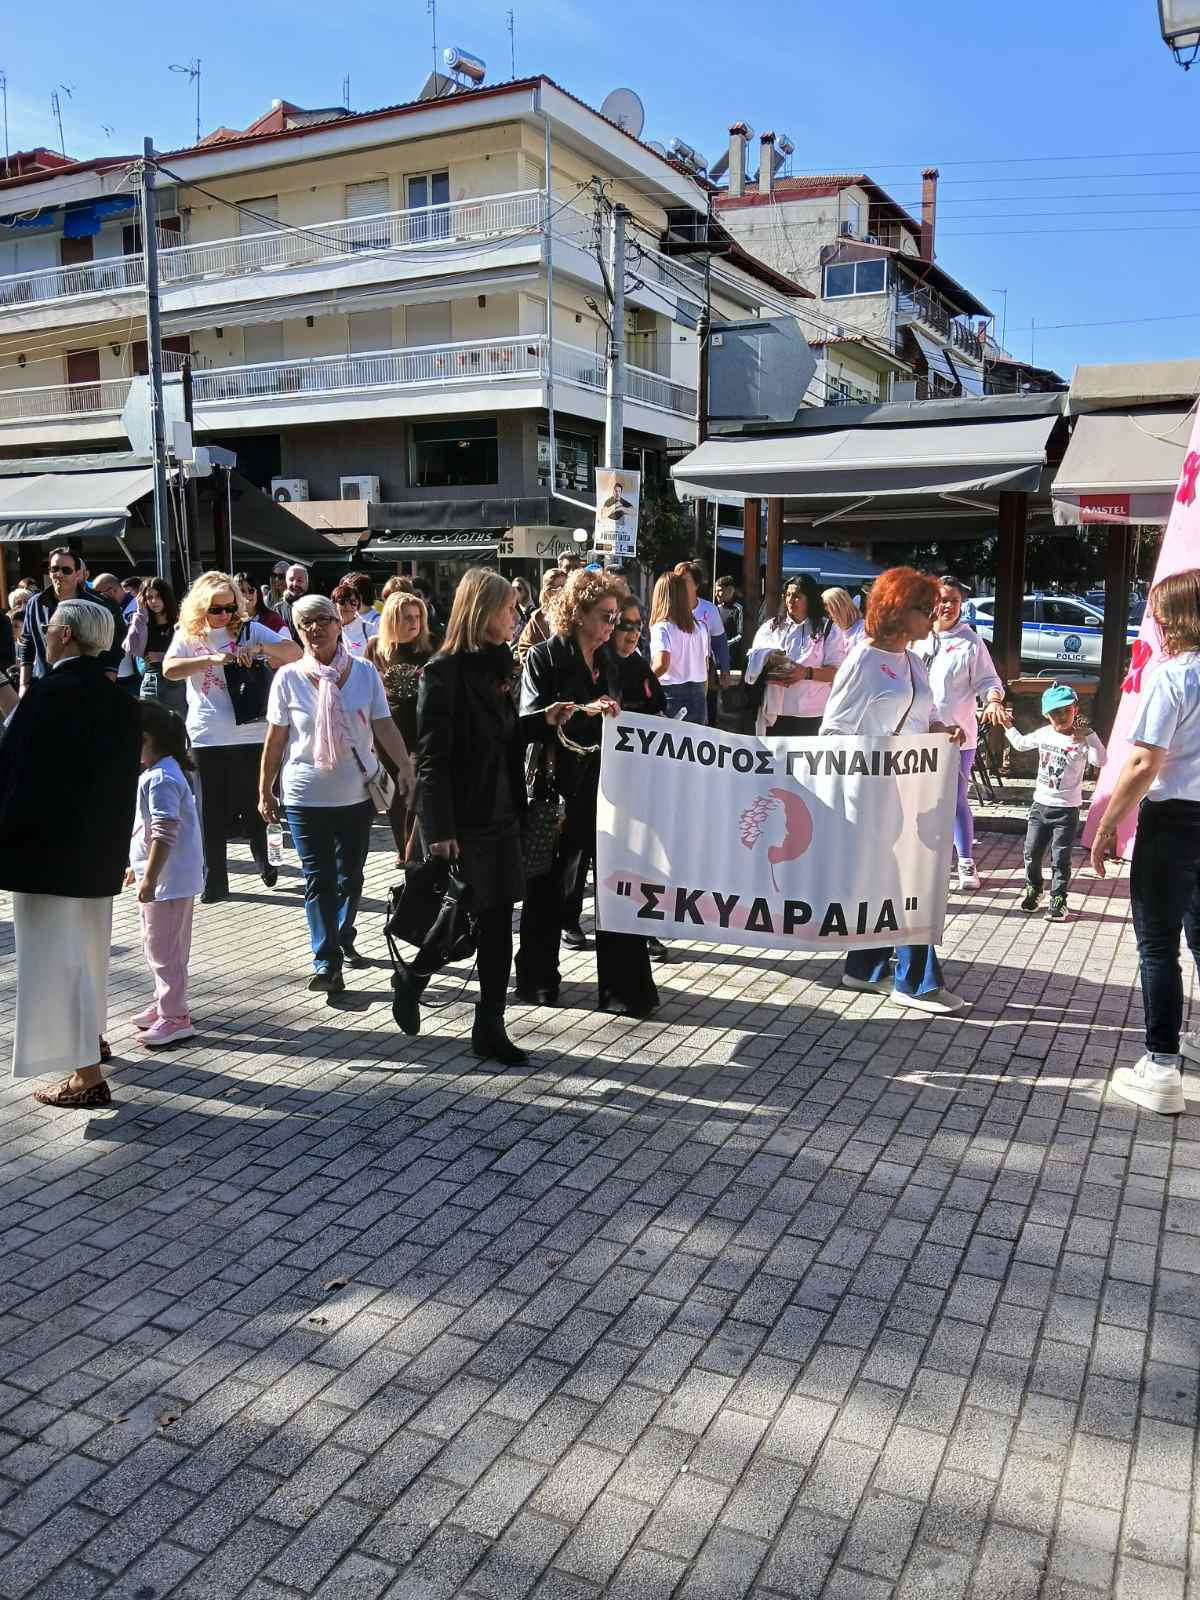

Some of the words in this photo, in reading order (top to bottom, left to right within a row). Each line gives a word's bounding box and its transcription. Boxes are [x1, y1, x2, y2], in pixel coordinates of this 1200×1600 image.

[1082, 504, 1127, 514] AMSTEL
[1056, 653, 1087, 661] POLICE
[614, 725, 774, 775] ΣΥΛΛΟΓΟΣ
[786, 747, 939, 776] ΓΥΝΑΙΚΩΝ
[616, 880, 918, 937] "ΣΚΥΔΡΑΙΑ"
